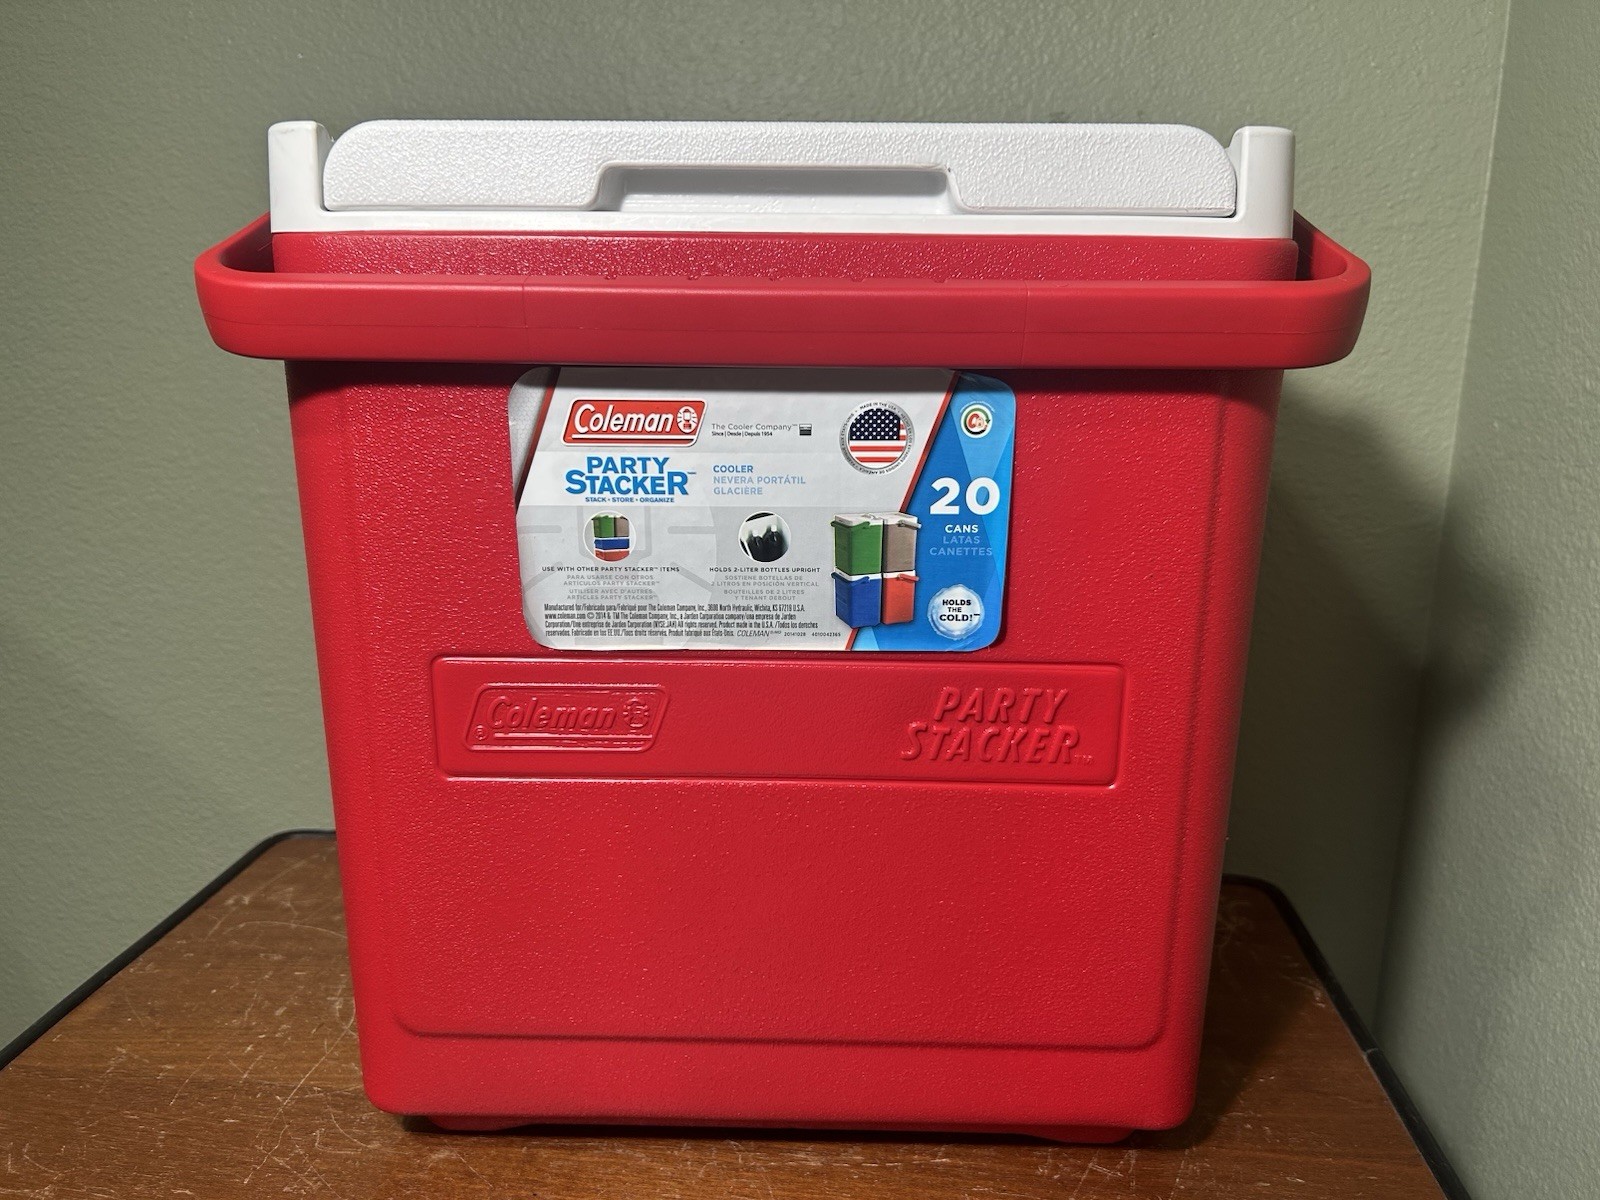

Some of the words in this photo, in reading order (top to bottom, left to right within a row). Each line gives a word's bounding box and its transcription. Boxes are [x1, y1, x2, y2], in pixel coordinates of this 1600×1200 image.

[859, 402, 872, 410] MADE
[574, 404, 674, 433] Coleman
[711, 423, 726, 431] The
[727, 423, 753, 431] Cooler
[586, 456, 670, 474] PARTY
[713, 465, 754, 473] COOLER
[713, 476, 754, 484] NEVERA
[756, 474, 806, 484] PORTÁTIL
[713, 486, 763, 495] GLACIÈRE
[930, 477, 1000, 515] 20
[945, 524, 979, 533] CANS
[943, 536, 980, 544] LATAS
[929, 547, 992, 556] CANETTES
[933, 686, 1069, 724] PARTY
[486, 696, 617, 729] Coleman
